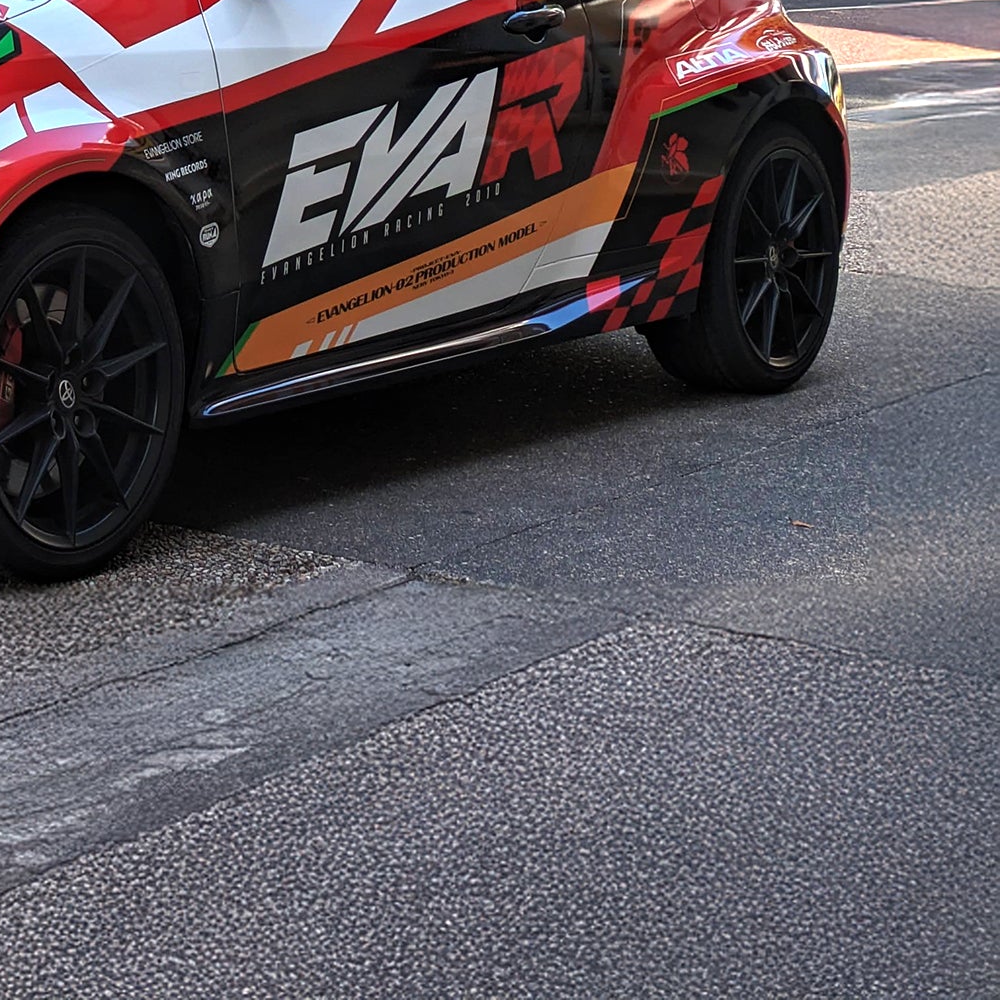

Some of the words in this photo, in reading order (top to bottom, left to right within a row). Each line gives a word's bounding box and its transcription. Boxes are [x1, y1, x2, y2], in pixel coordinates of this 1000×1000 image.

[143, 138, 182, 160] EVANGELION
[182, 131, 203, 147] STORE
[165, 167, 181, 182] KING
[181, 159, 208, 177] RECORDS
[260, 230, 369, 285] EVANGELION
[384, 203, 444, 238] RACING
[465, 182, 501, 207] 2010
[414, 242, 496, 284] PRODUCTION
[498, 223, 538, 249] MODEL
